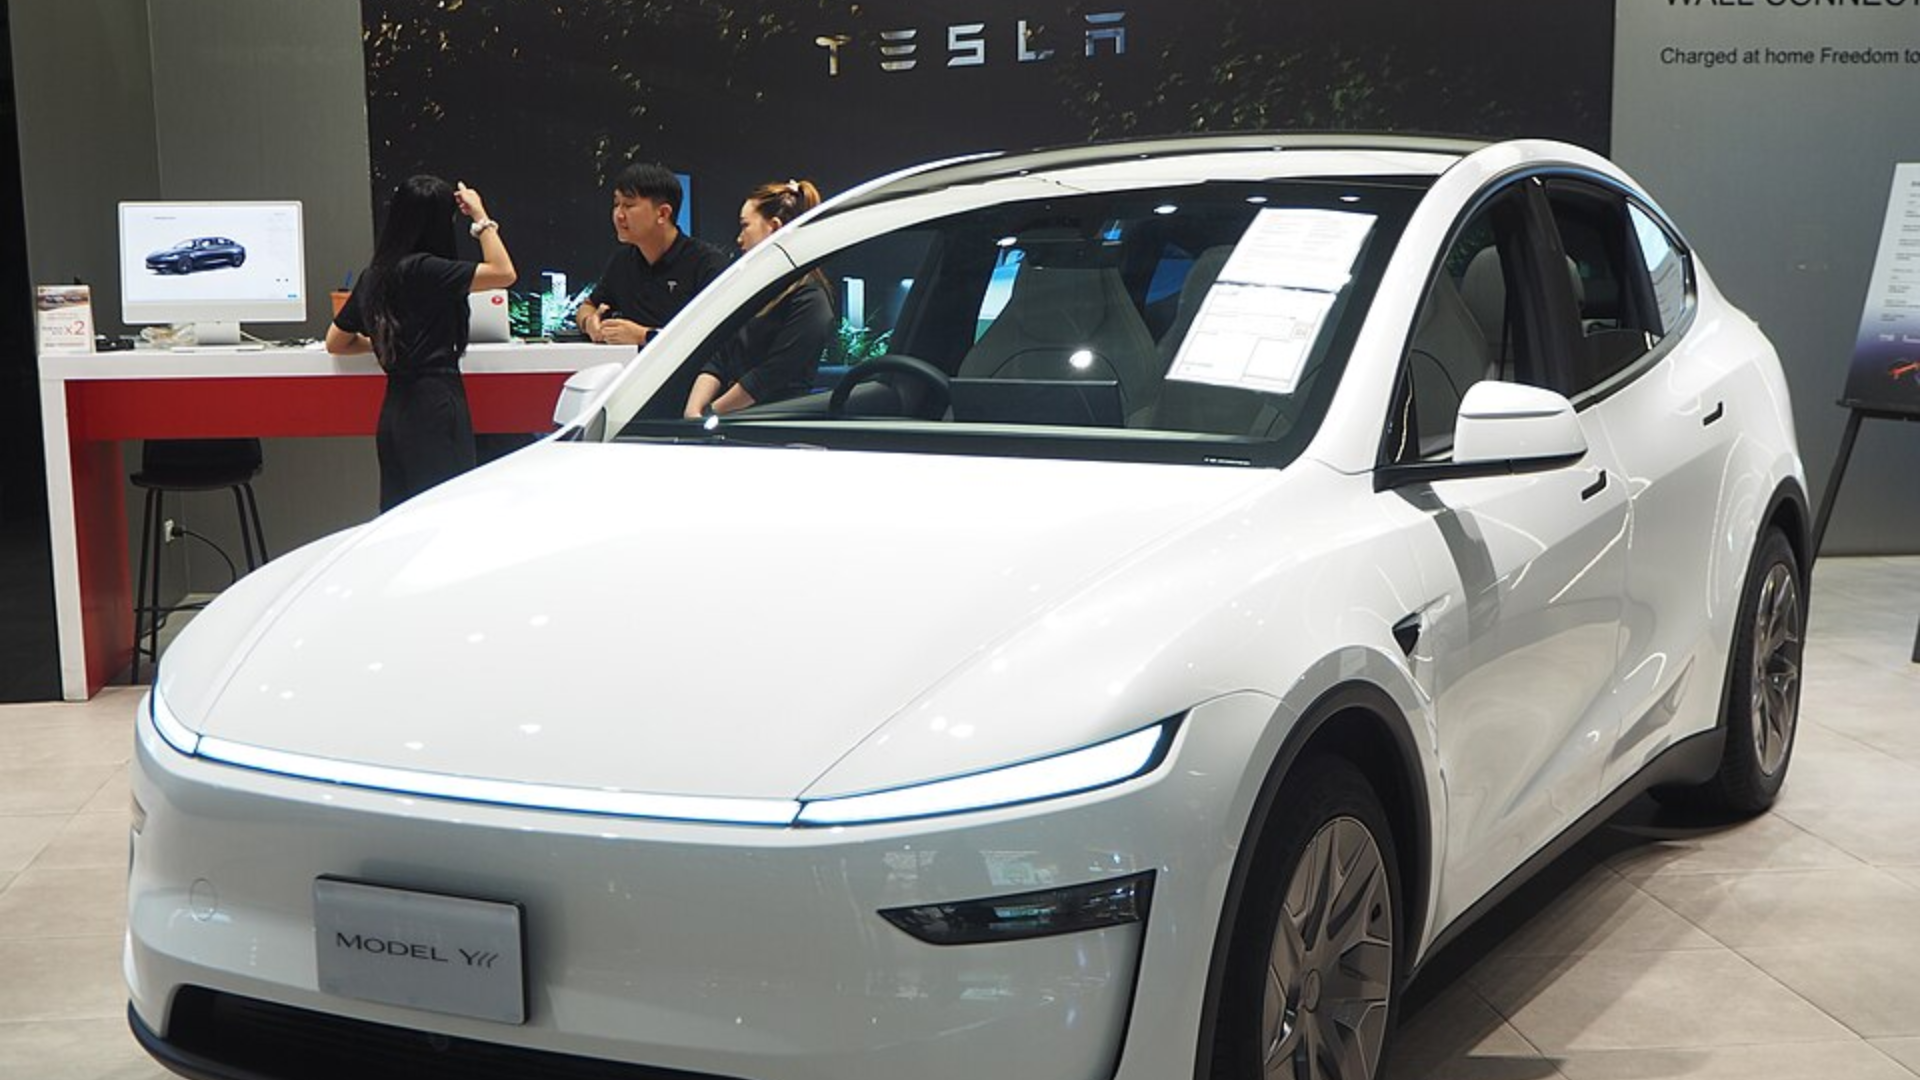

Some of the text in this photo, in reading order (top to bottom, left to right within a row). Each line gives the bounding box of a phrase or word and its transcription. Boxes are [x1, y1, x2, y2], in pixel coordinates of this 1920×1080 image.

[815, 12, 1126, 76] TESLA
[1660, 47, 1920, 67] Charged at home Freedom to
[337, 932, 449, 962] MODEL
